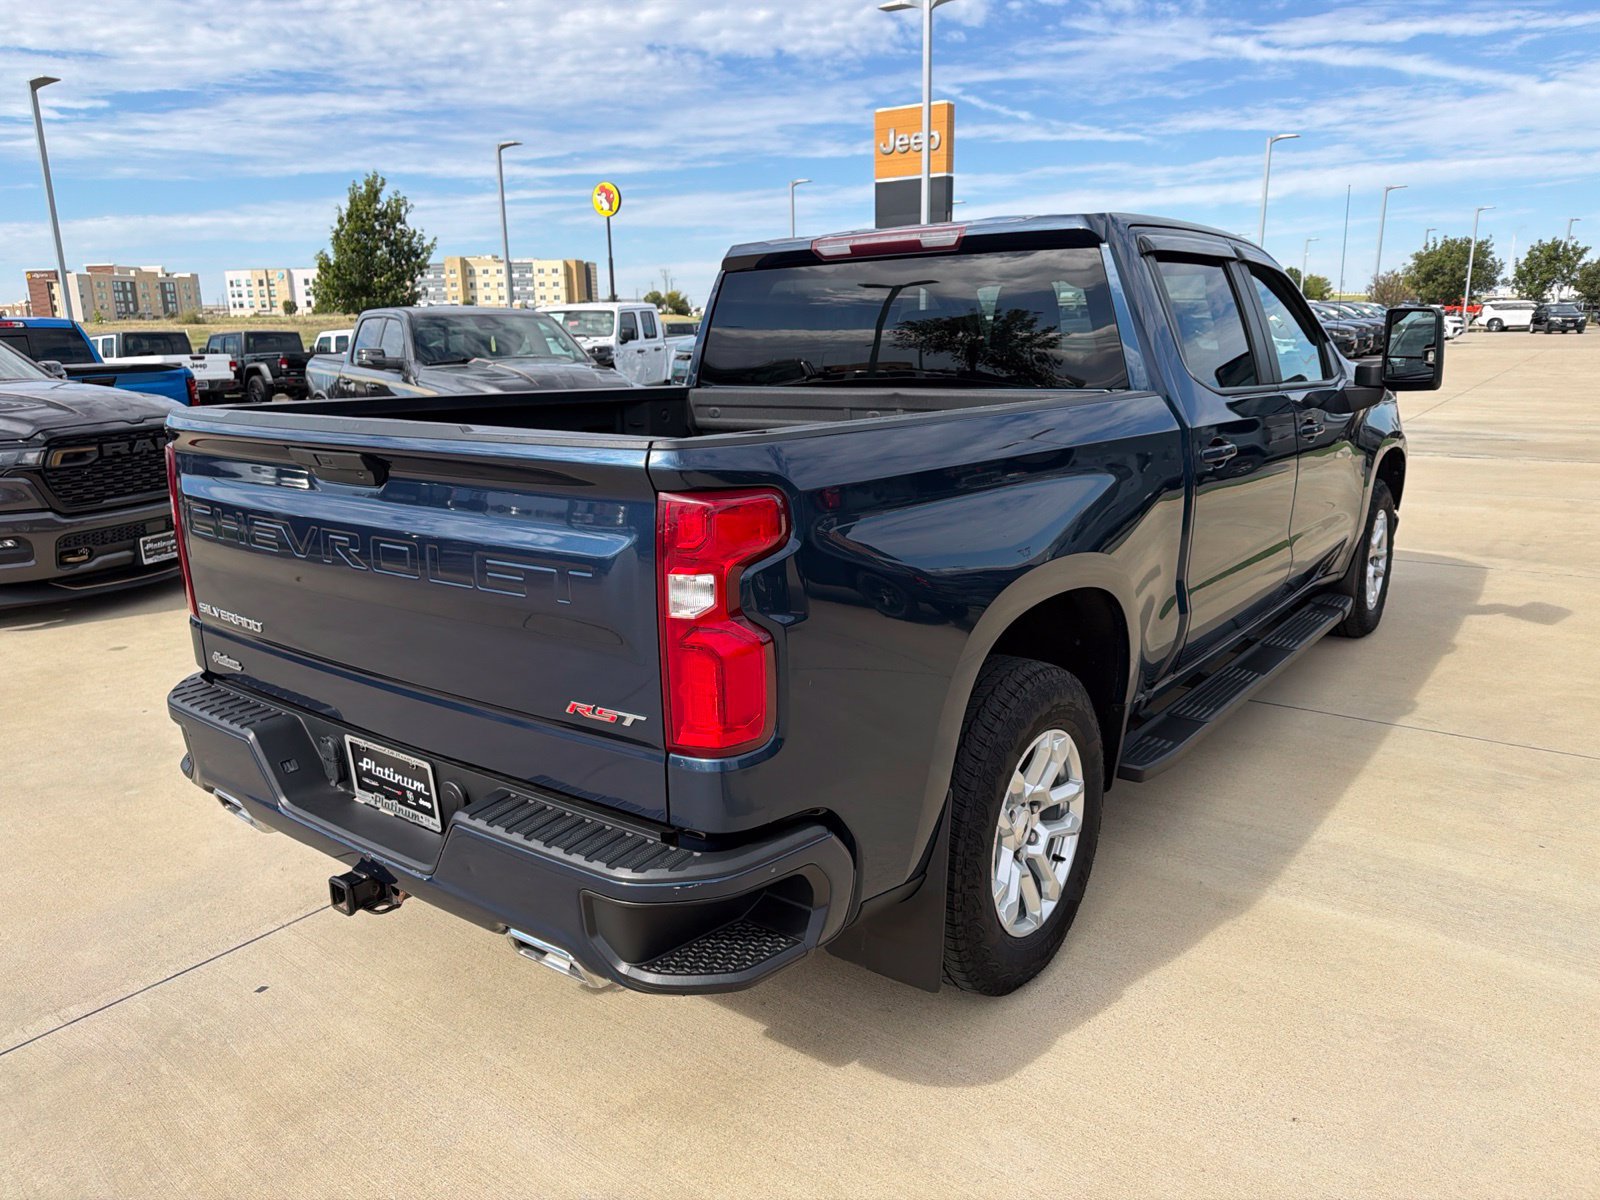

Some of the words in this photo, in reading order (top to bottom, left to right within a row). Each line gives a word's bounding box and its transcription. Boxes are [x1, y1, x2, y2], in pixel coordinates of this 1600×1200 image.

[189, 502, 594, 605] CHEVROLET
[198, 602, 263, 633] SILVERADO
[565, 700, 647, 727] RST
[358, 757, 430, 796] Platinum
[374, 793, 424, 825] Platinum
